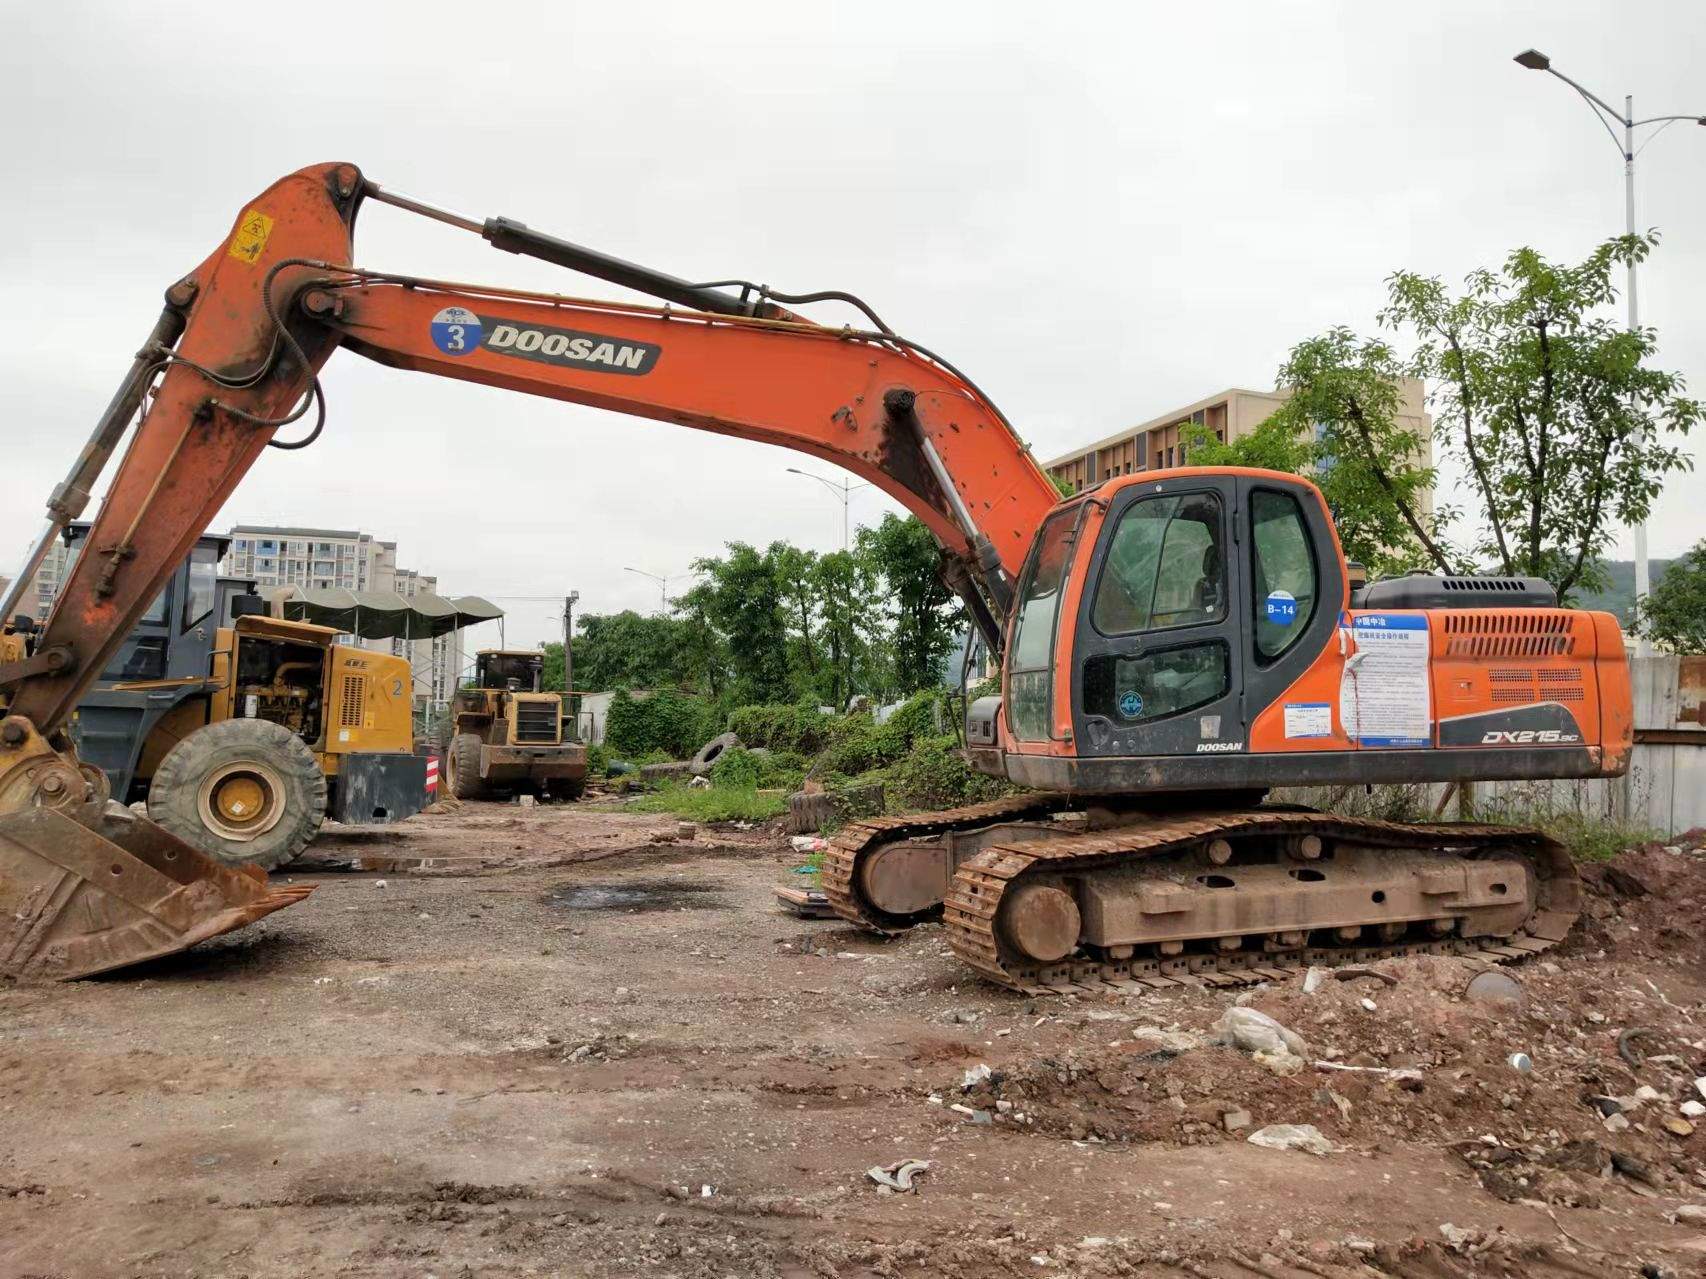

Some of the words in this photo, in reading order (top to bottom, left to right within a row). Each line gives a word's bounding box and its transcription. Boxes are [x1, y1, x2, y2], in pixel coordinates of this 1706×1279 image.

[447, 325, 465, 350] 3
[488, 325, 646, 369] DOOSAN
[1267, 604, 1294, 615] B-14
[393, 680, 403, 696] 2
[1196, 743, 1243, 752] DOOSAN
